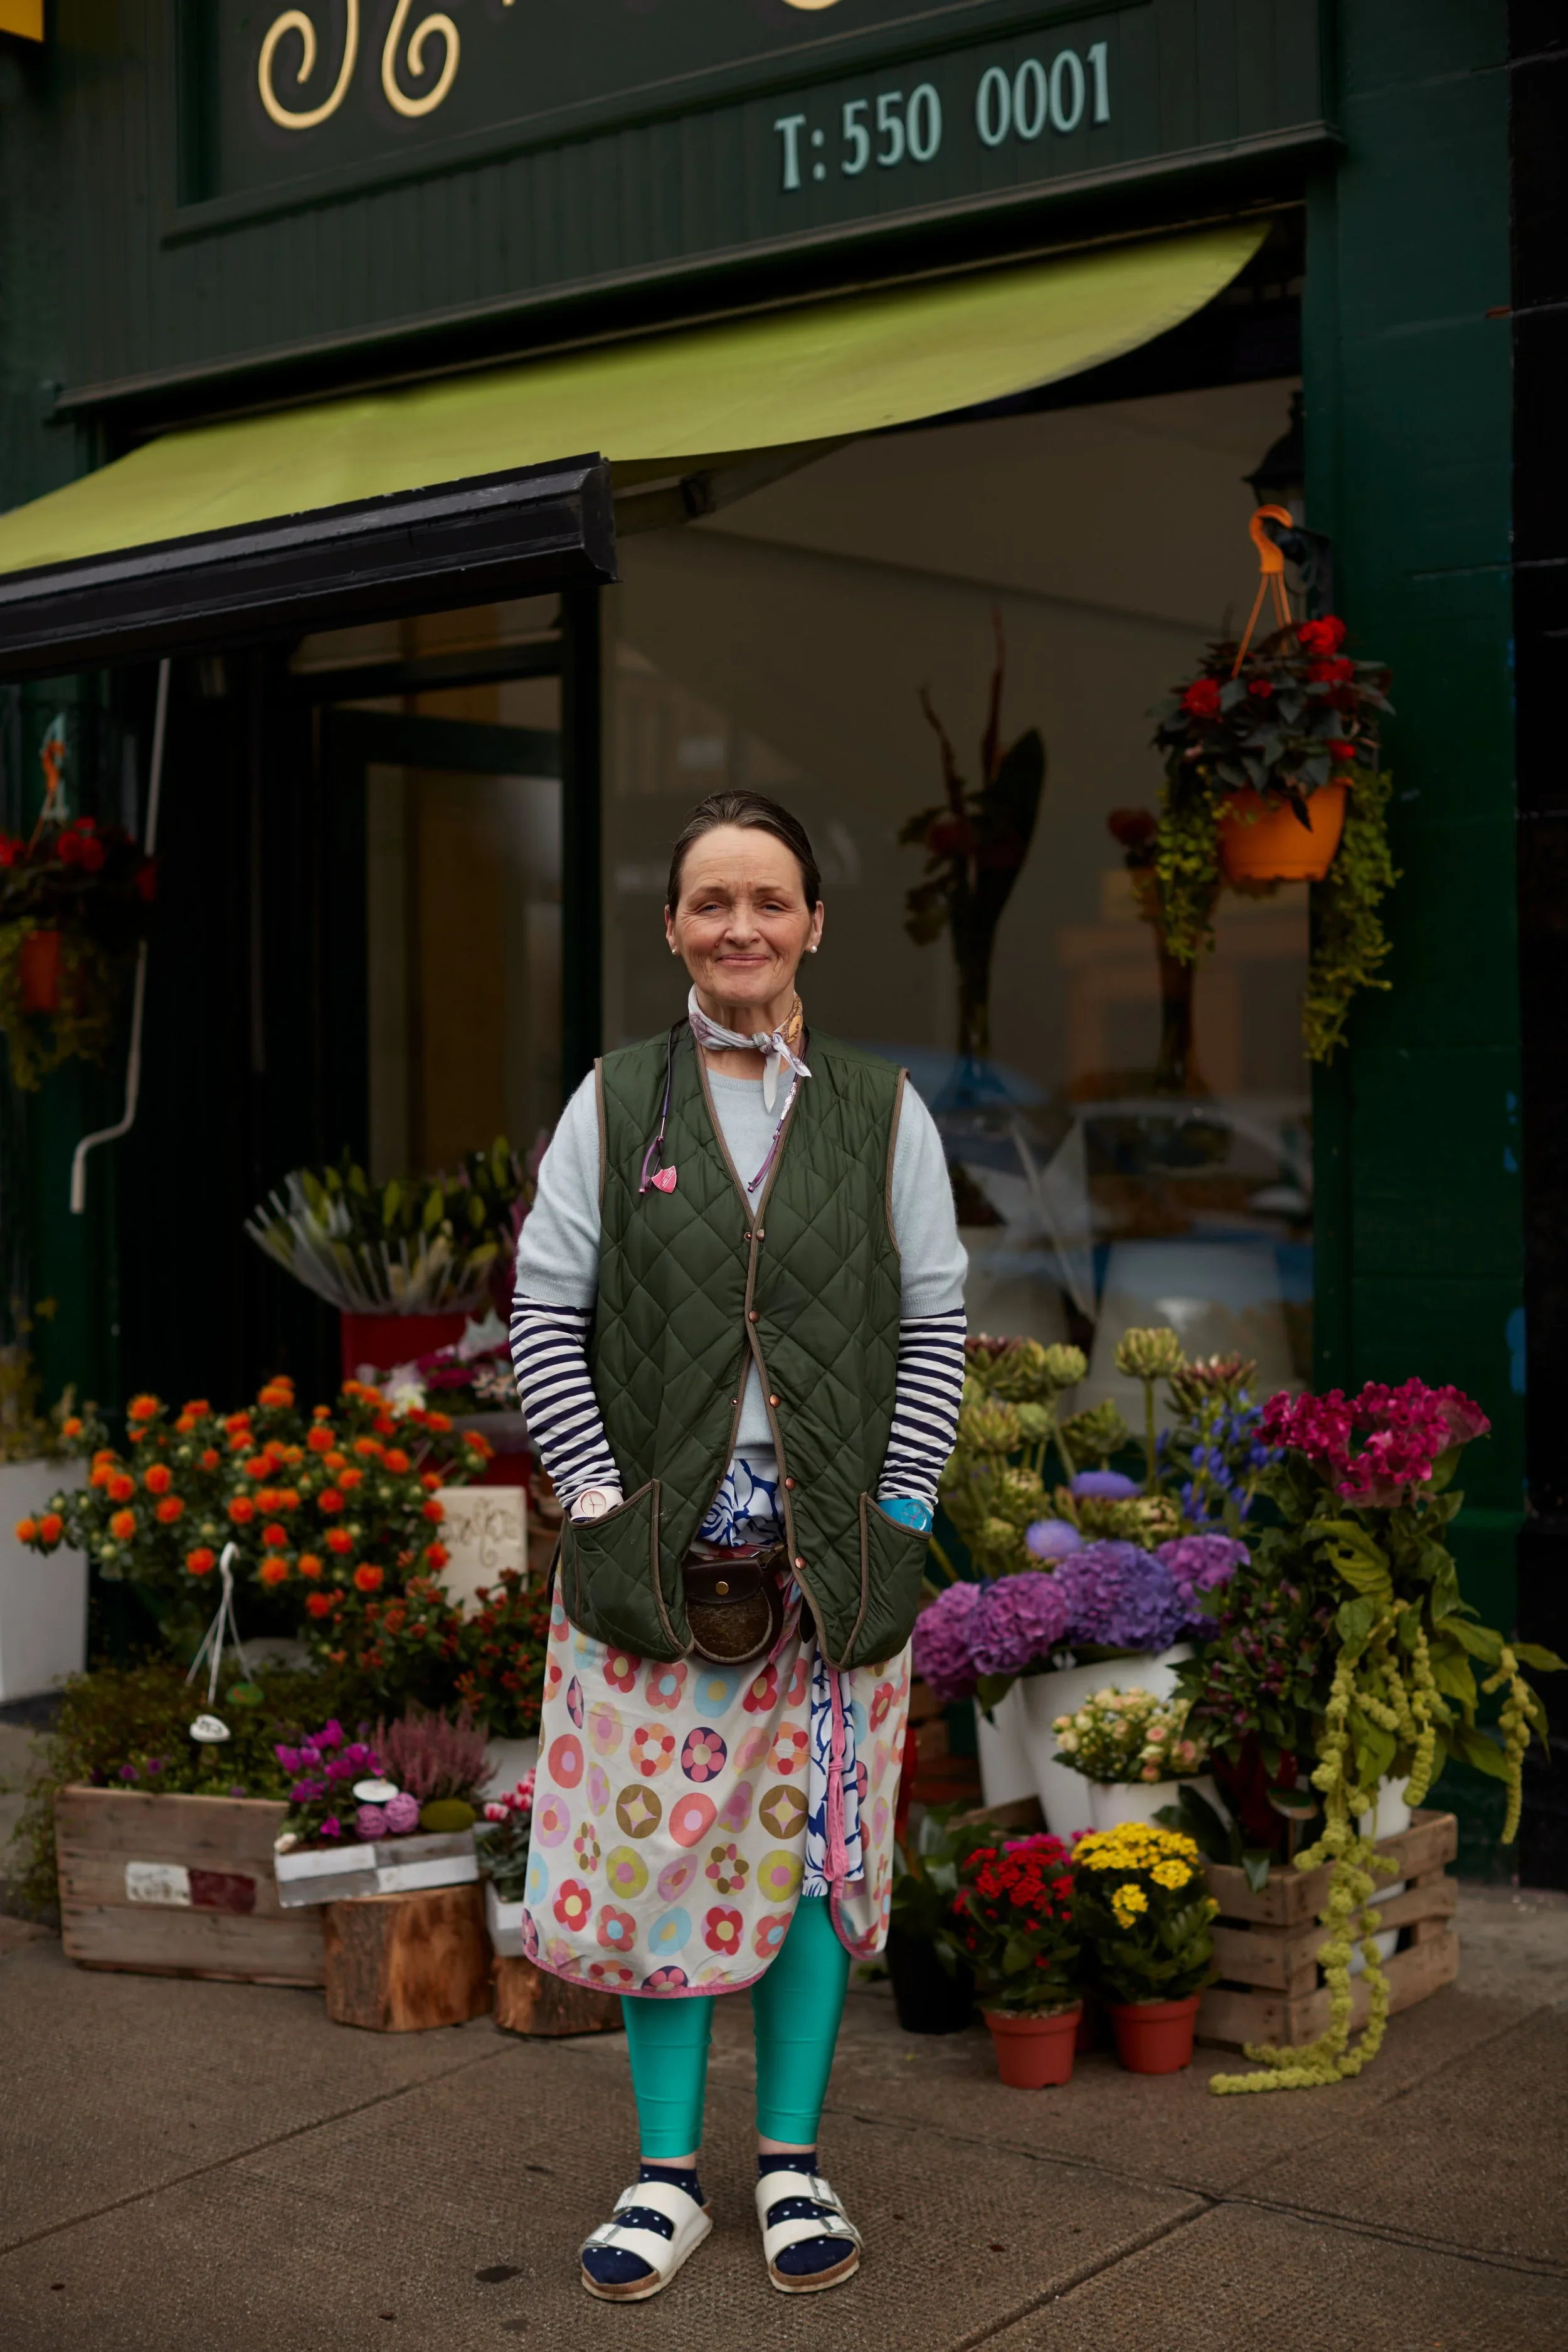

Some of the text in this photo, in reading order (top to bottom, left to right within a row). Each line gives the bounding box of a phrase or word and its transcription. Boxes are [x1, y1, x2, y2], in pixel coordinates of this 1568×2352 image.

[841, 83, 942, 174] 550
[976, 41, 1110, 146] 0001
[667, 1169, 675, 1178] GIRL
